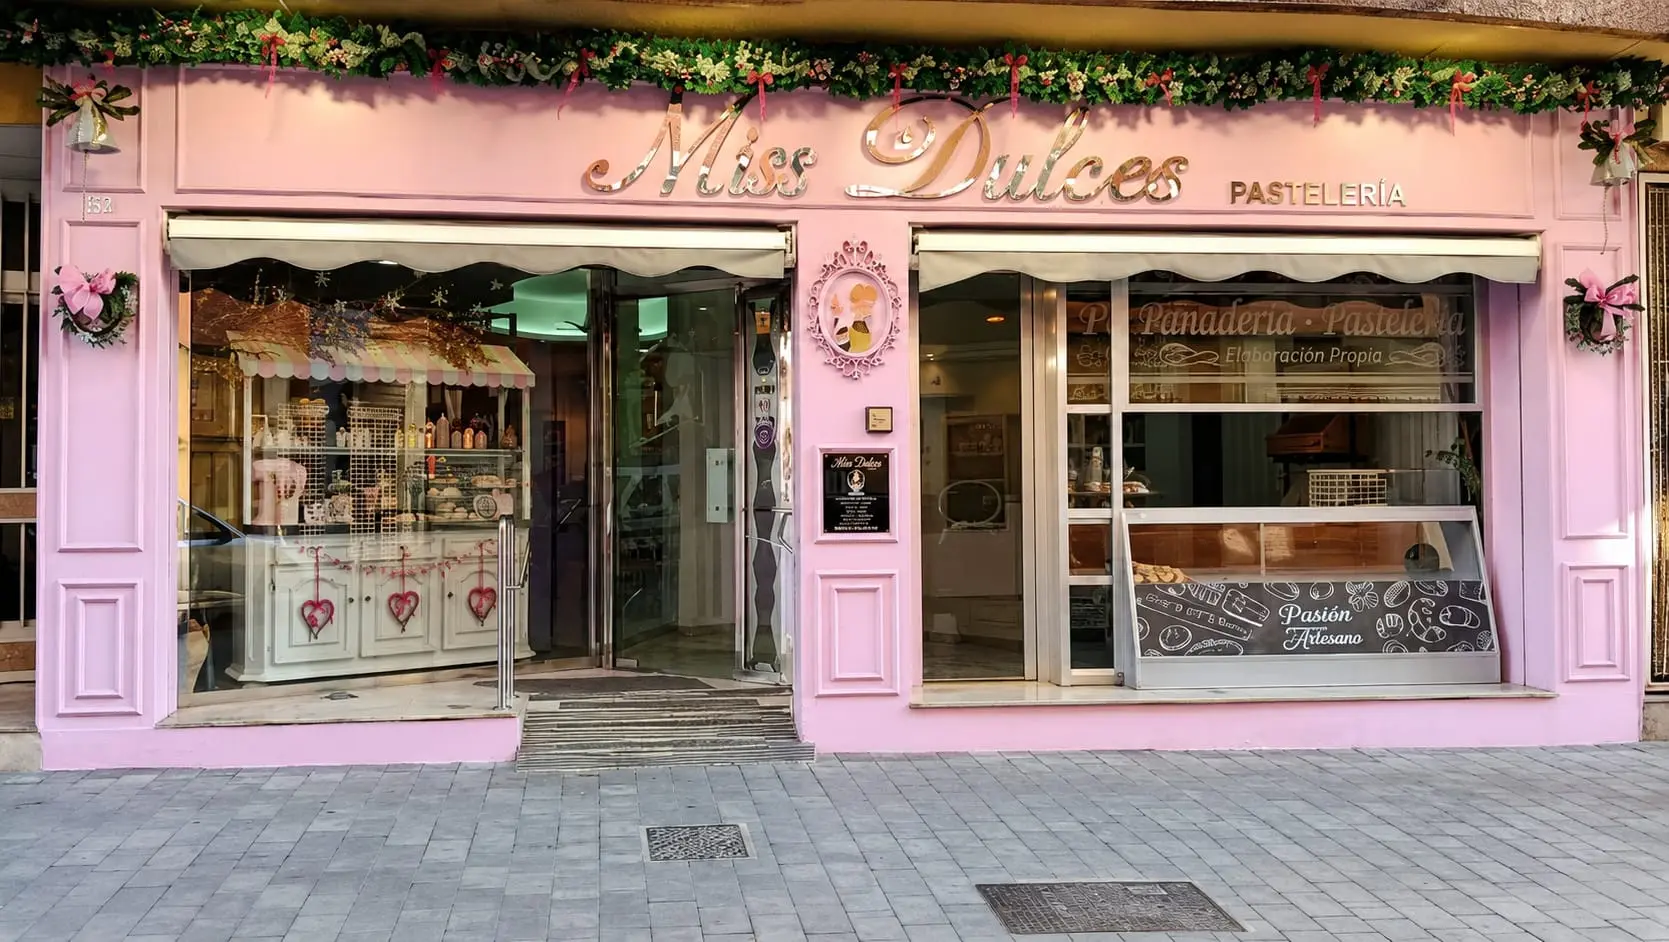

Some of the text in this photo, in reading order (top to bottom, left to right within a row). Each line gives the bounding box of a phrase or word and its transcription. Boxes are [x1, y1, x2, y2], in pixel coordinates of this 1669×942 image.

[586, 86, 1190, 203] Miss Dulces
[1230, 178, 1407, 208] PASTELERÍA
[1225, 346, 1384, 368] Elaboración Propia
[1278, 603, 1353, 625] Pasión
[1282, 626, 1364, 651] Artesano
